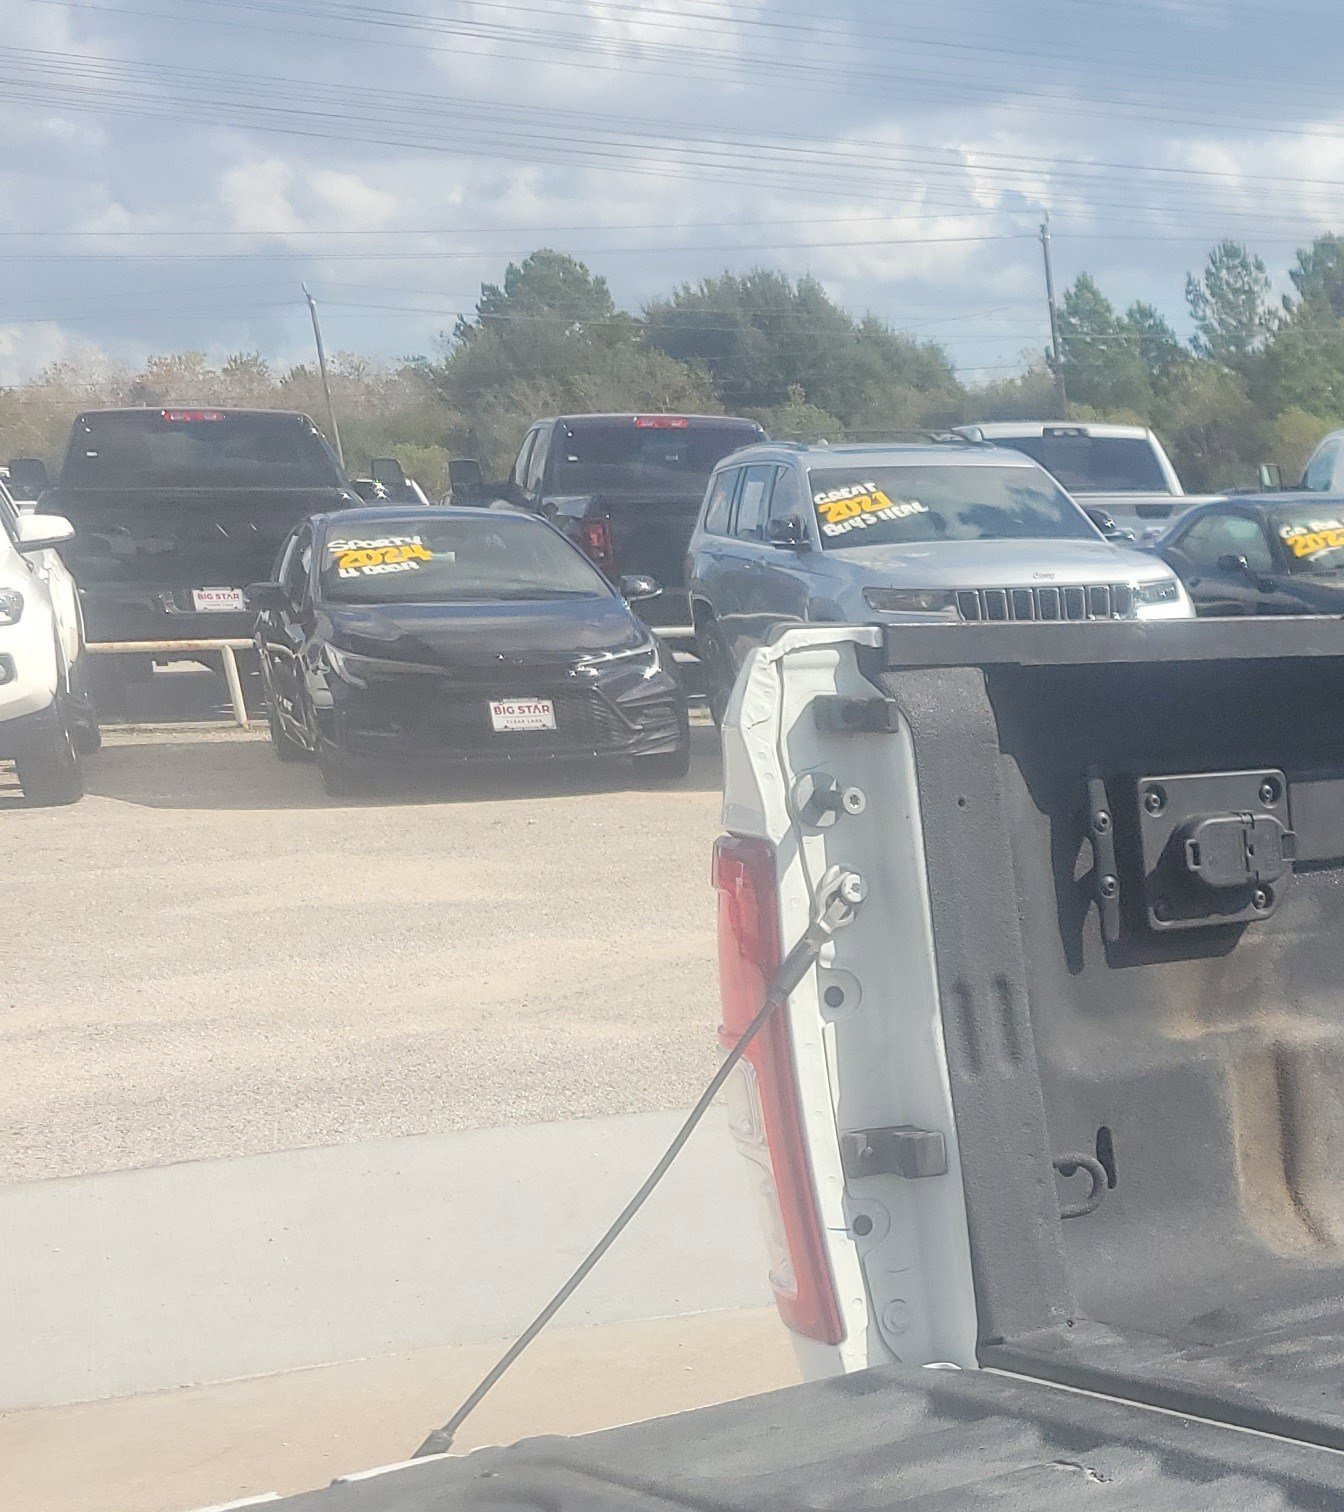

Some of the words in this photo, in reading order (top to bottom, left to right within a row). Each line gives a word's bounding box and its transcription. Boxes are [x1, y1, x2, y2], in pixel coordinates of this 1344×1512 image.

[814, 482, 878, 504] GREAT
[818, 491, 893, 524] 2021
[333, 544, 432, 569] 2024
[493, 705, 516, 715] BIG
[517, 704, 551, 715] STAR
